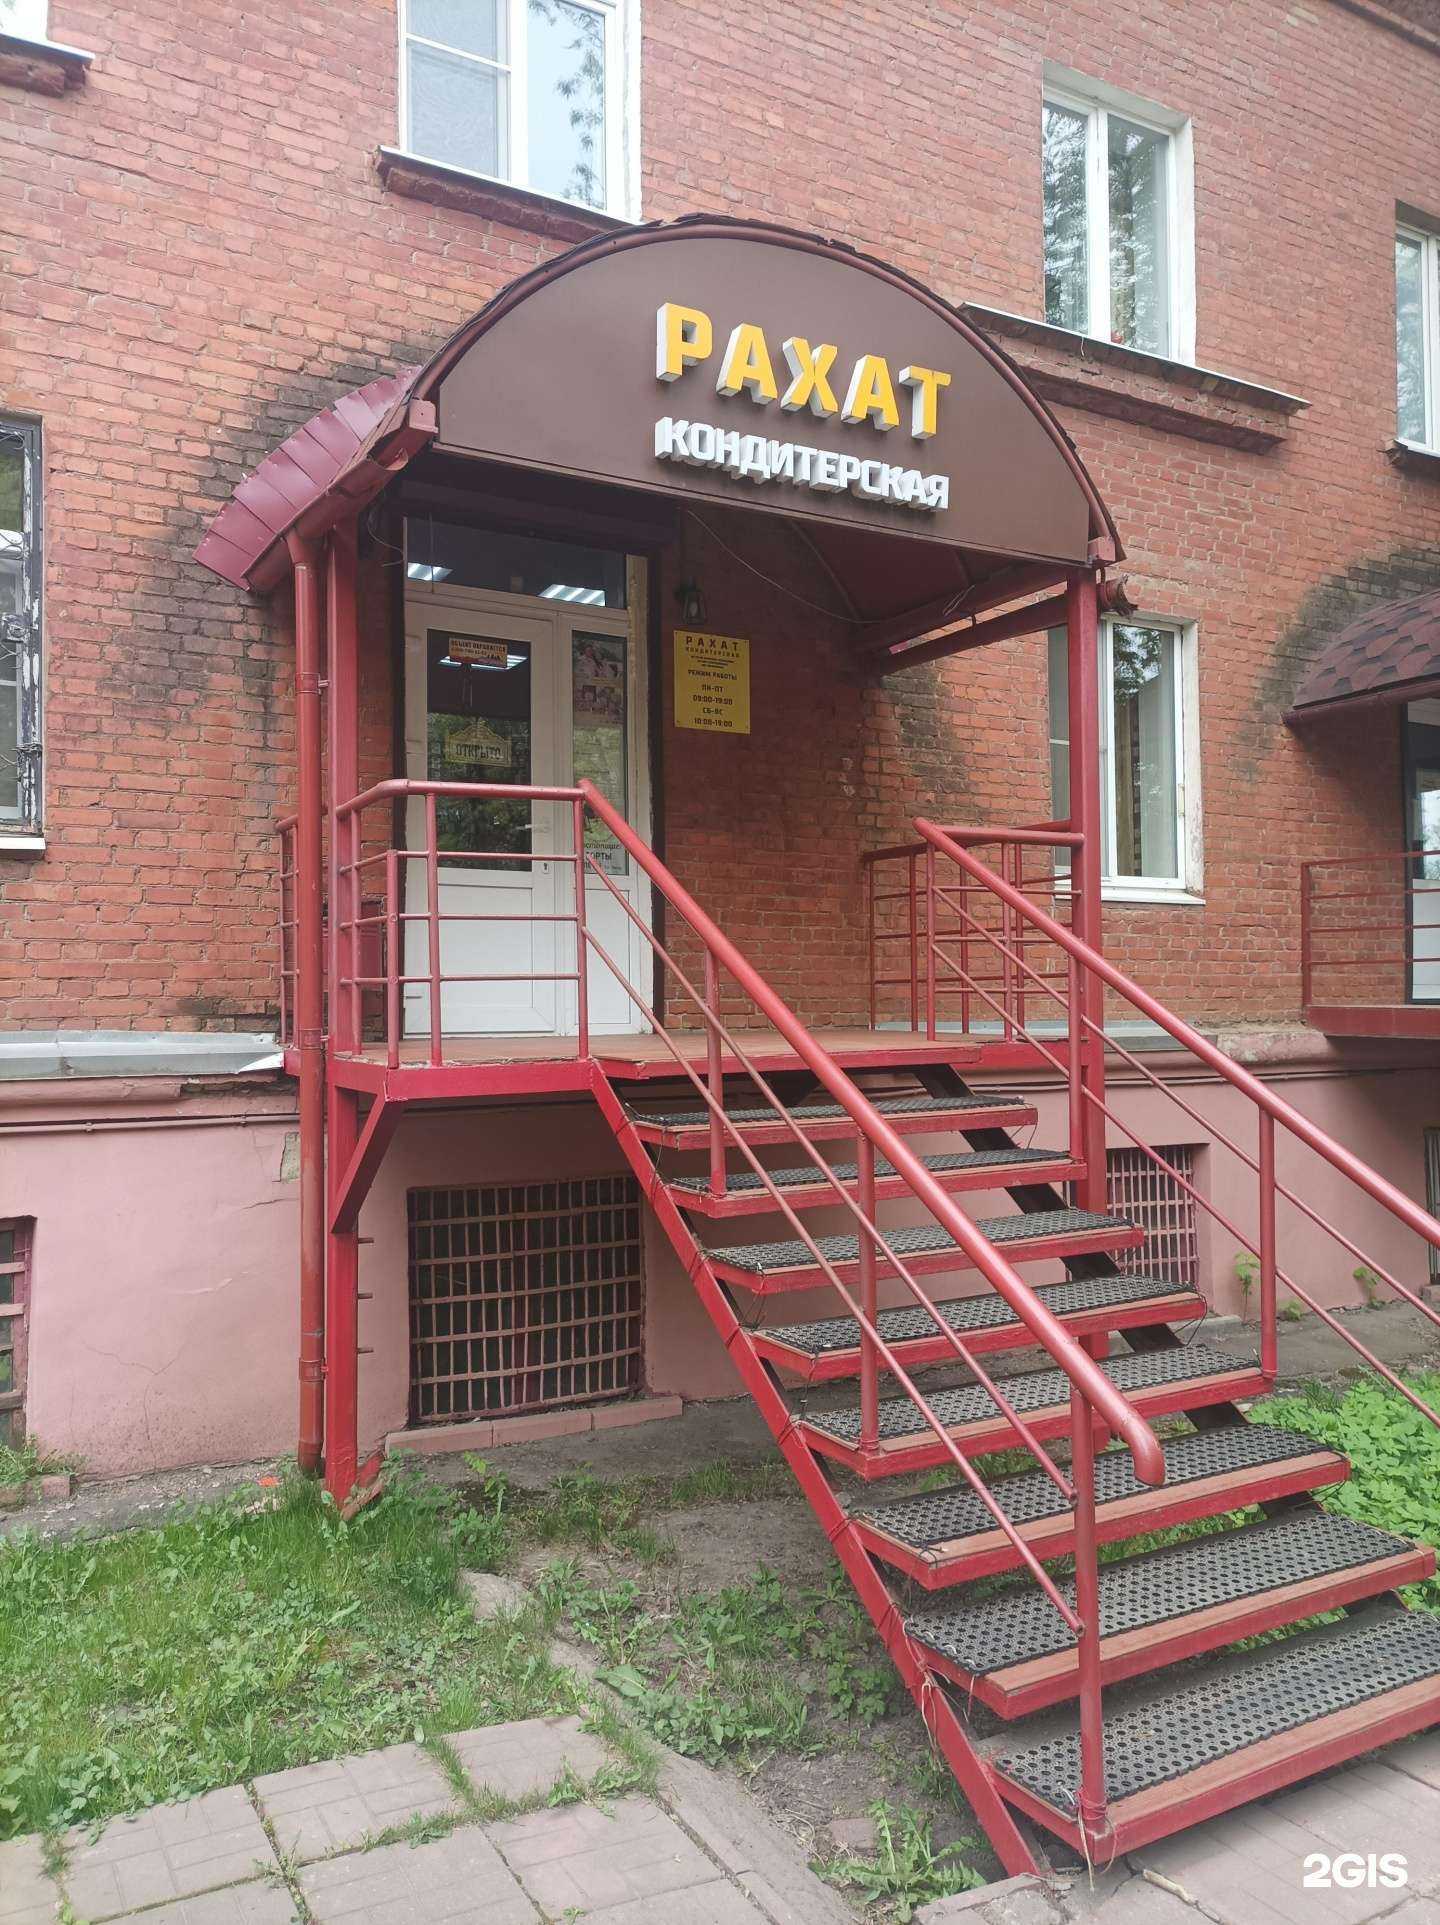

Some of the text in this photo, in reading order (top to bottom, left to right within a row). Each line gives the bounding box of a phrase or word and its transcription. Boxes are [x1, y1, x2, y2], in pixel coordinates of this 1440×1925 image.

[656, 302, 951, 439] РАХАТ
[655, 416, 949, 510] КОНДИТЕРСКАЯ
[686, 636, 739, 651] РАХАТ
[713, 672, 737, 680] РАБОТЫ
[701, 684, 724, 692] ПН-ПТ
[456, 743, 501, 760] ОТКРЫТО
